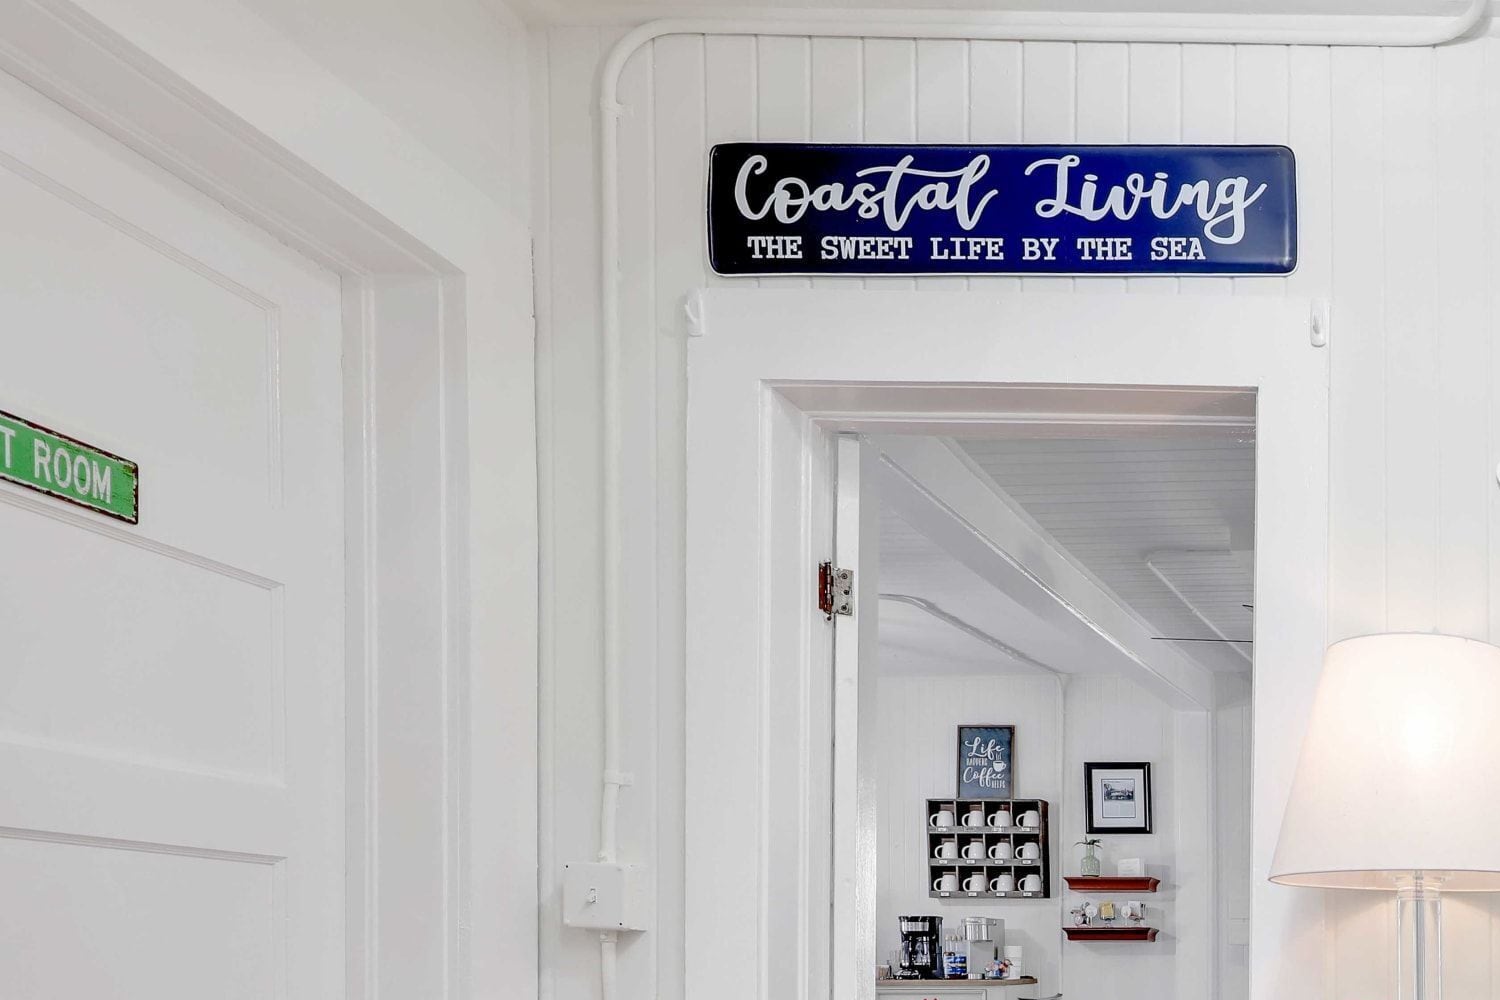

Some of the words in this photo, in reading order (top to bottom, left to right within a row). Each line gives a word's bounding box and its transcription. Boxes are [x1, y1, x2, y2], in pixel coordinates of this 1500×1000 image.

[734, 154, 999, 231] Coastal
[1023, 154, 1267, 245] Living
[747, 236, 802, 259] THE
[821, 236, 913, 260] SWEET
[931, 237, 1004, 260] LIFE
[1022, 237, 1060, 260] BY
[1077, 237, 1131, 261] THE
[1150, 237, 1206, 261] SEA
[33, 437, 112, 505] ROOM
[964, 736, 1005, 760] Life
[963, 766, 1005, 787] Coffee
